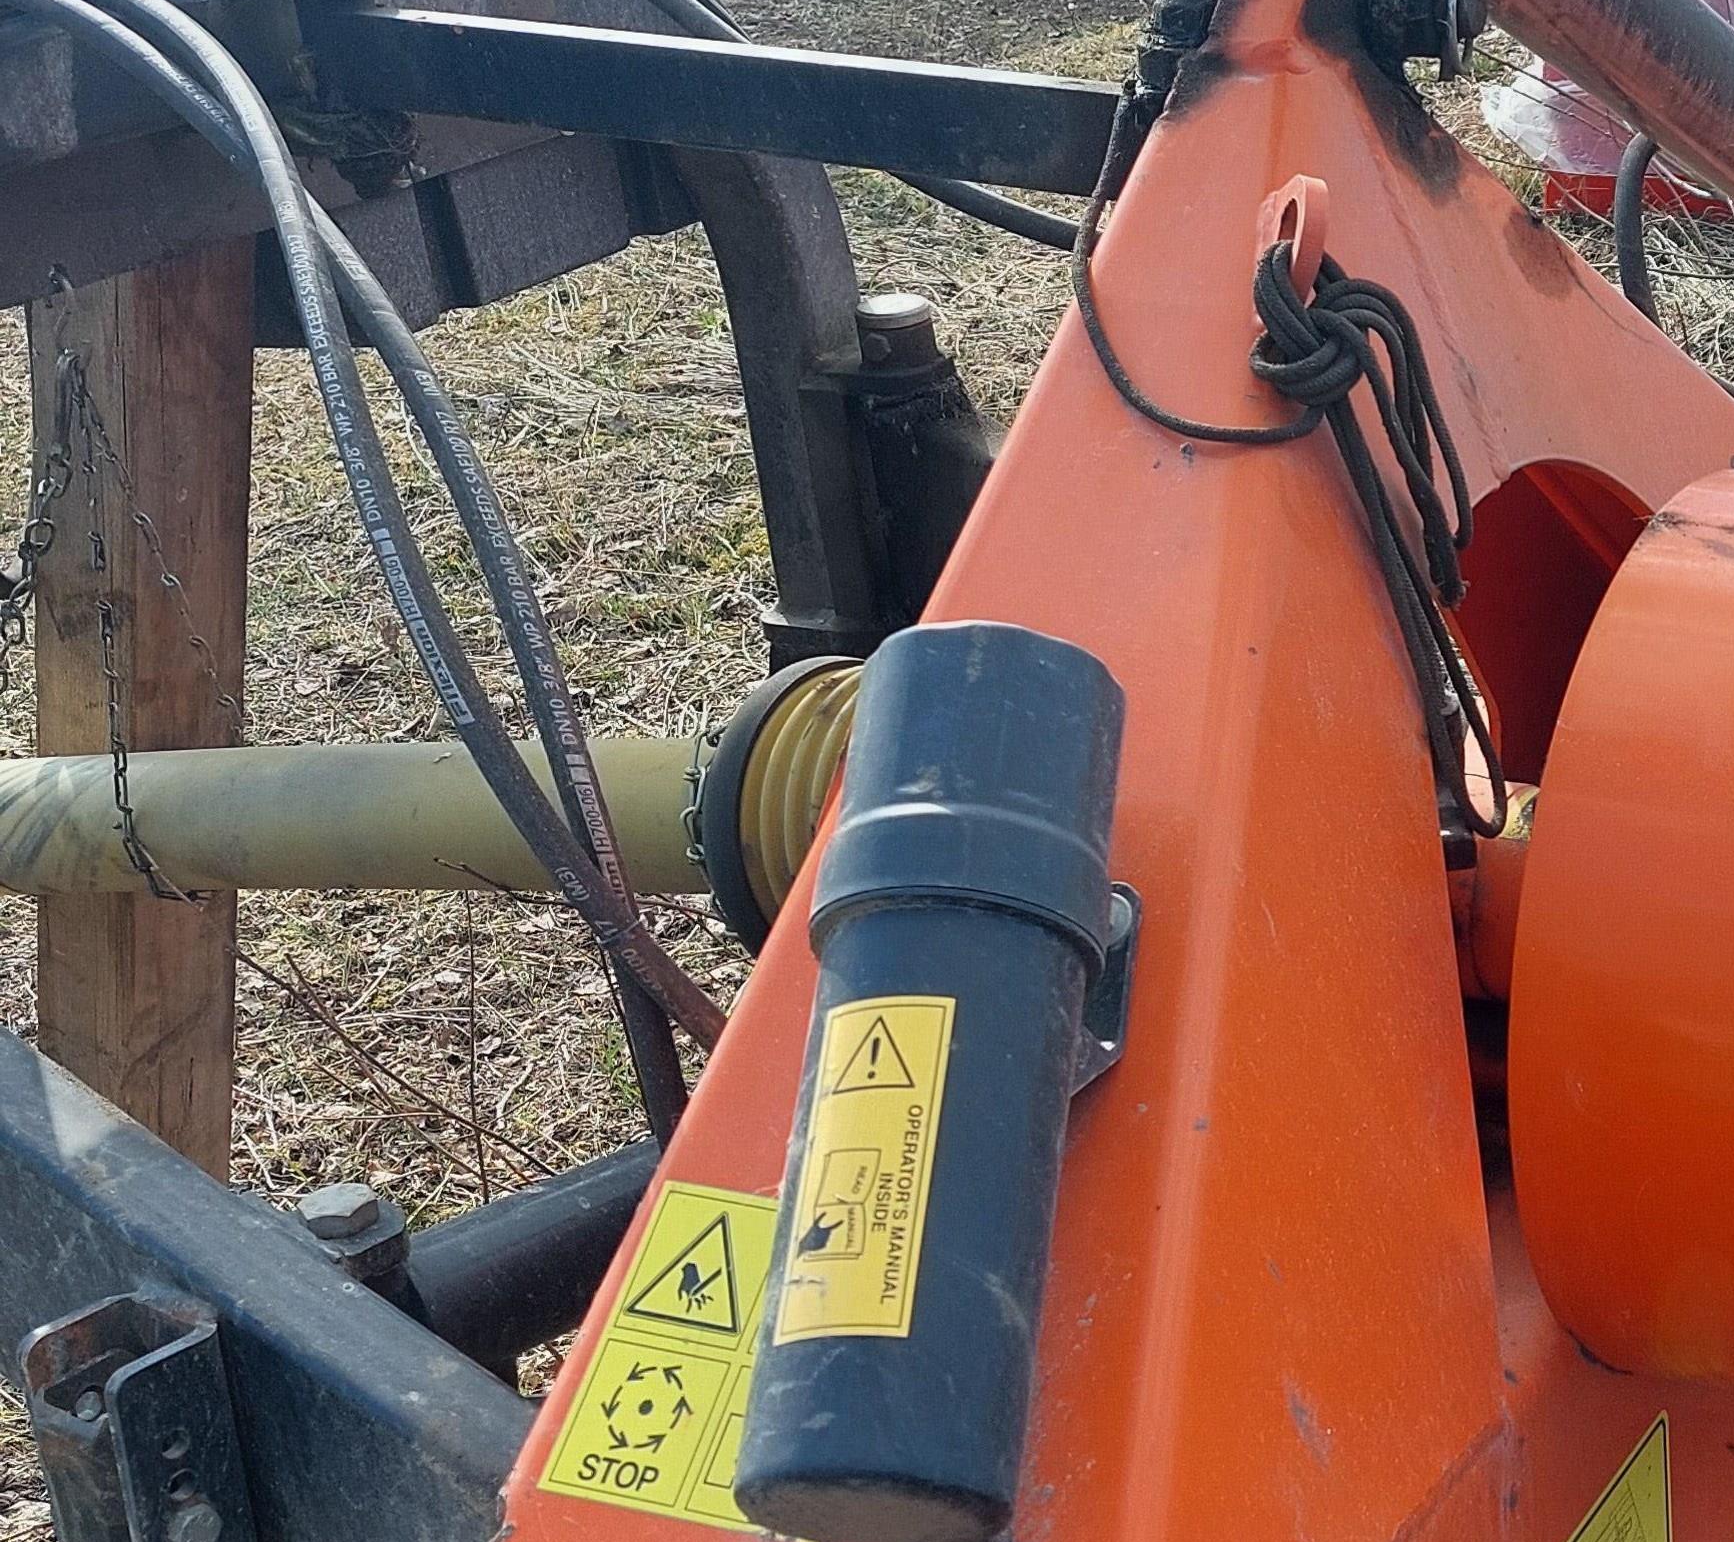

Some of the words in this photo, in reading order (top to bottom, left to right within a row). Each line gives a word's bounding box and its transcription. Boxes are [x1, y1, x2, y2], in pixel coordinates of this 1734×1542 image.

[318, 352, 339, 381] BAR
[500, 555, 524, 587] BAR
[893, 1105, 923, 1221] OPERATOR'S
[872, 1172, 894, 1233] INSIDE
[880, 1227, 908, 1305] MANUAL
[577, 1453, 660, 1492] STOP
